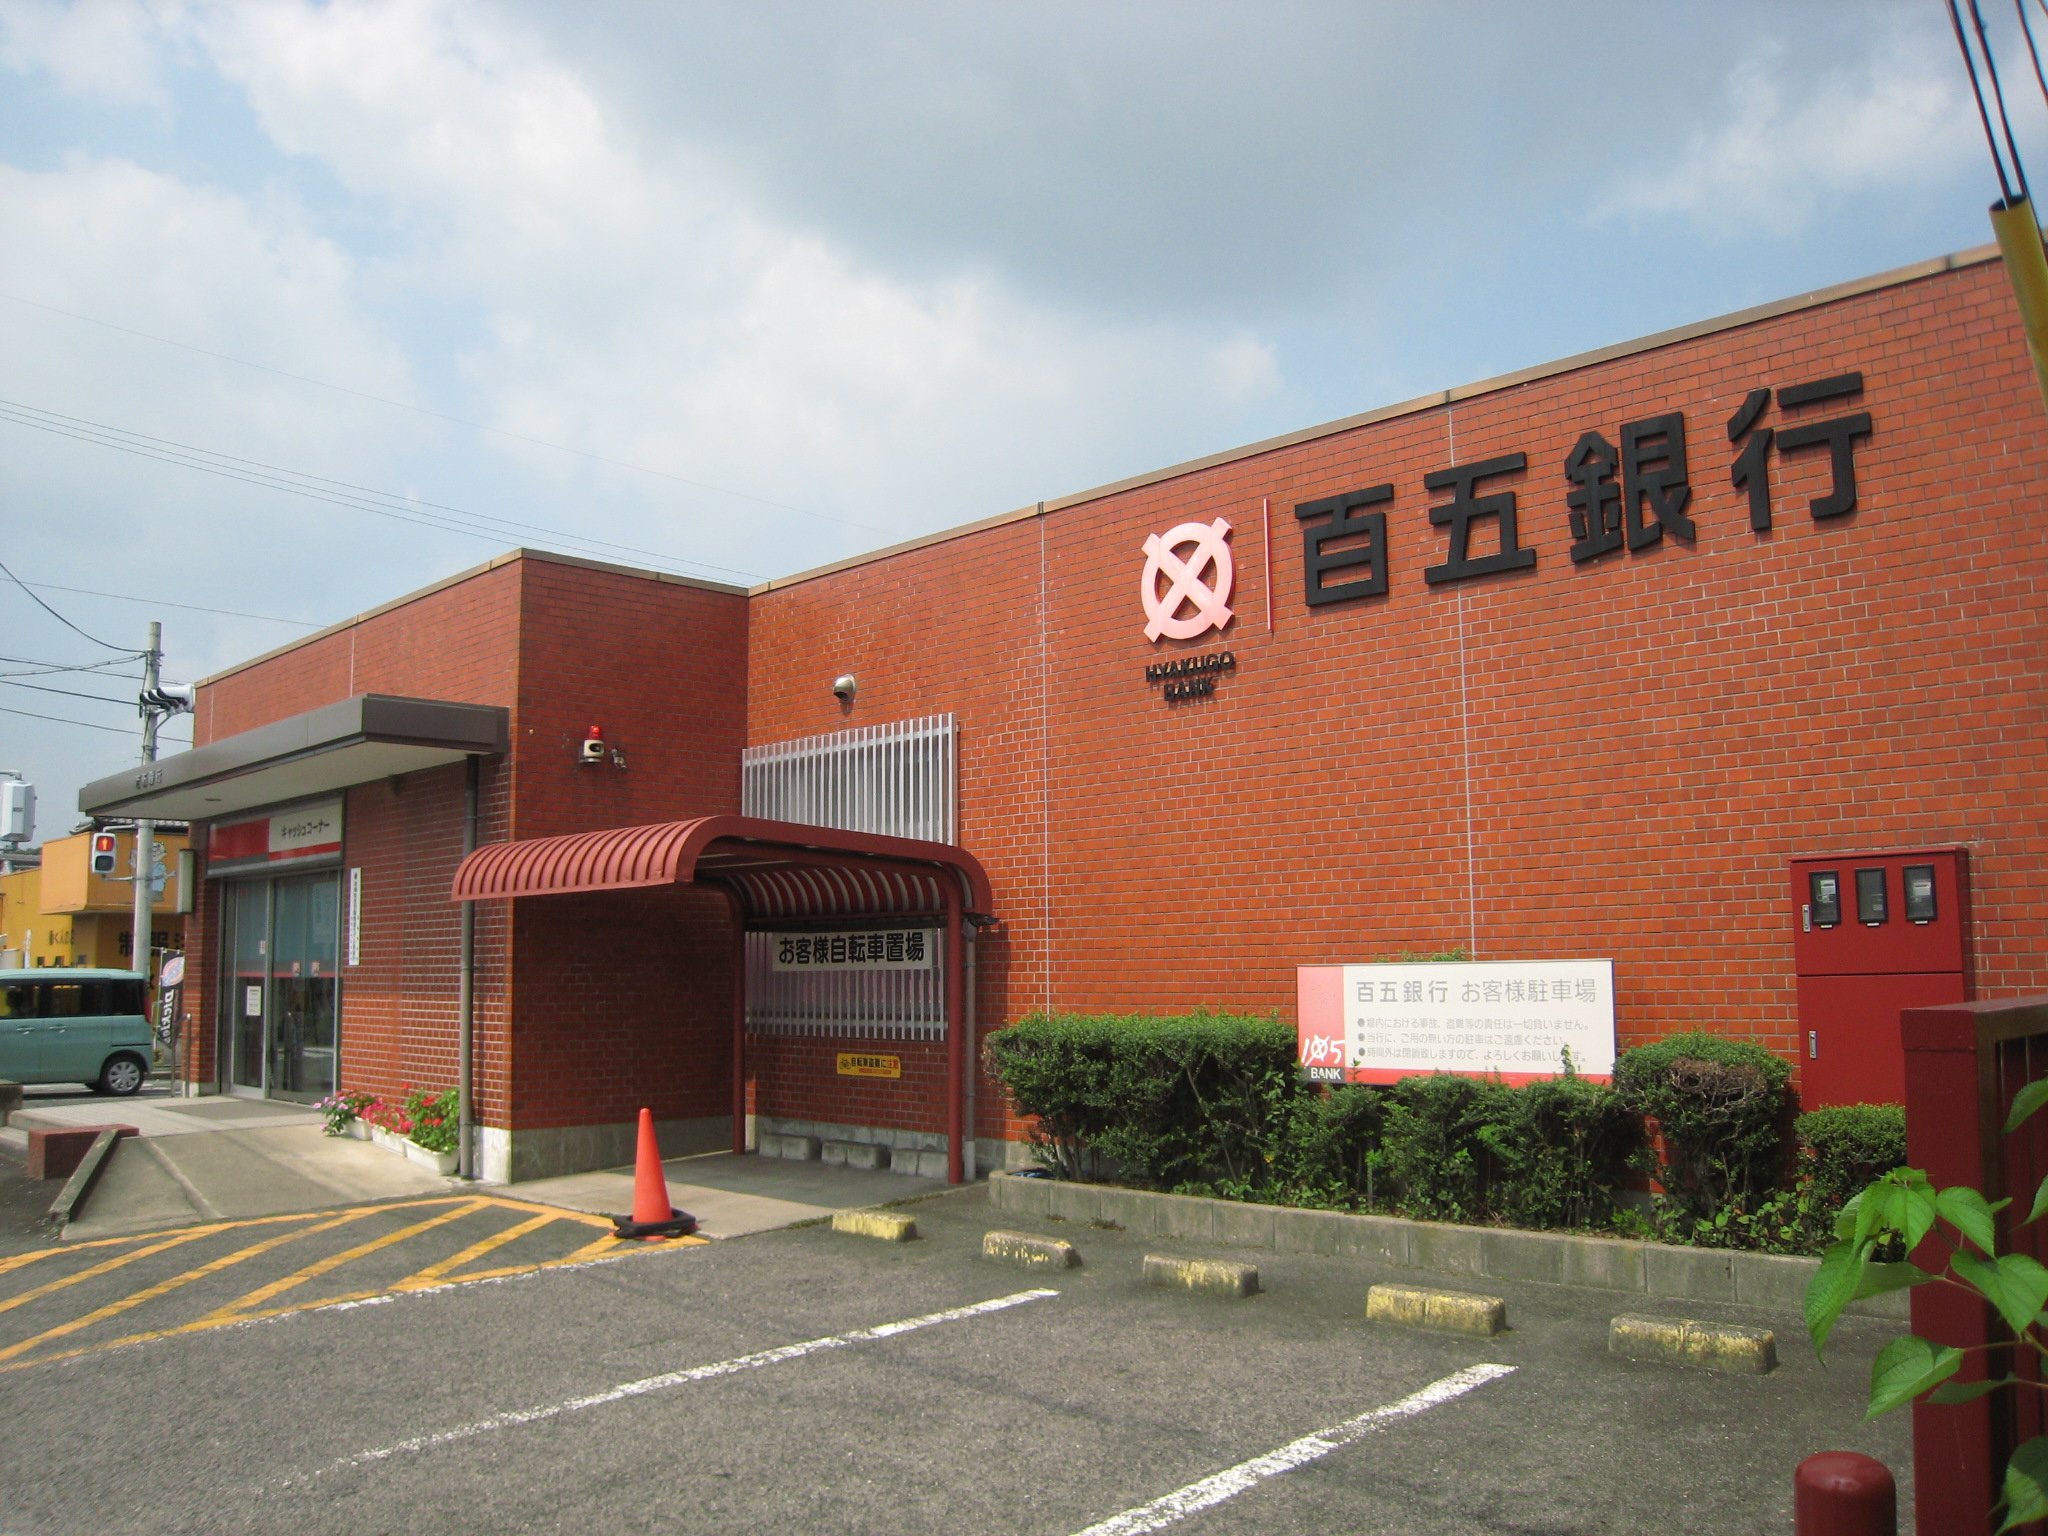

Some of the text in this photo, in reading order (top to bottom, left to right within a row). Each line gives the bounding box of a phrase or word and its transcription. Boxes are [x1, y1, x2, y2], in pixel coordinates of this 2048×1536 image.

[1295, 371, 1872, 607] 百五銀行
[1144, 651, 1236, 682] HYAKUGO
[1164, 677, 1214, 701] BANK
[281, 818, 331, 839] キャッシュコーナー
[778, 931, 925, 964] お客様自転車置場
[1356, 978, 1597, 1003] 百五銀行 お客様駐車場
[1367, 1047, 1587, 1062] 時間外は閉鎖致しますので、よろしくお願いしす。
[1310, 1067, 1341, 1080] BANK
